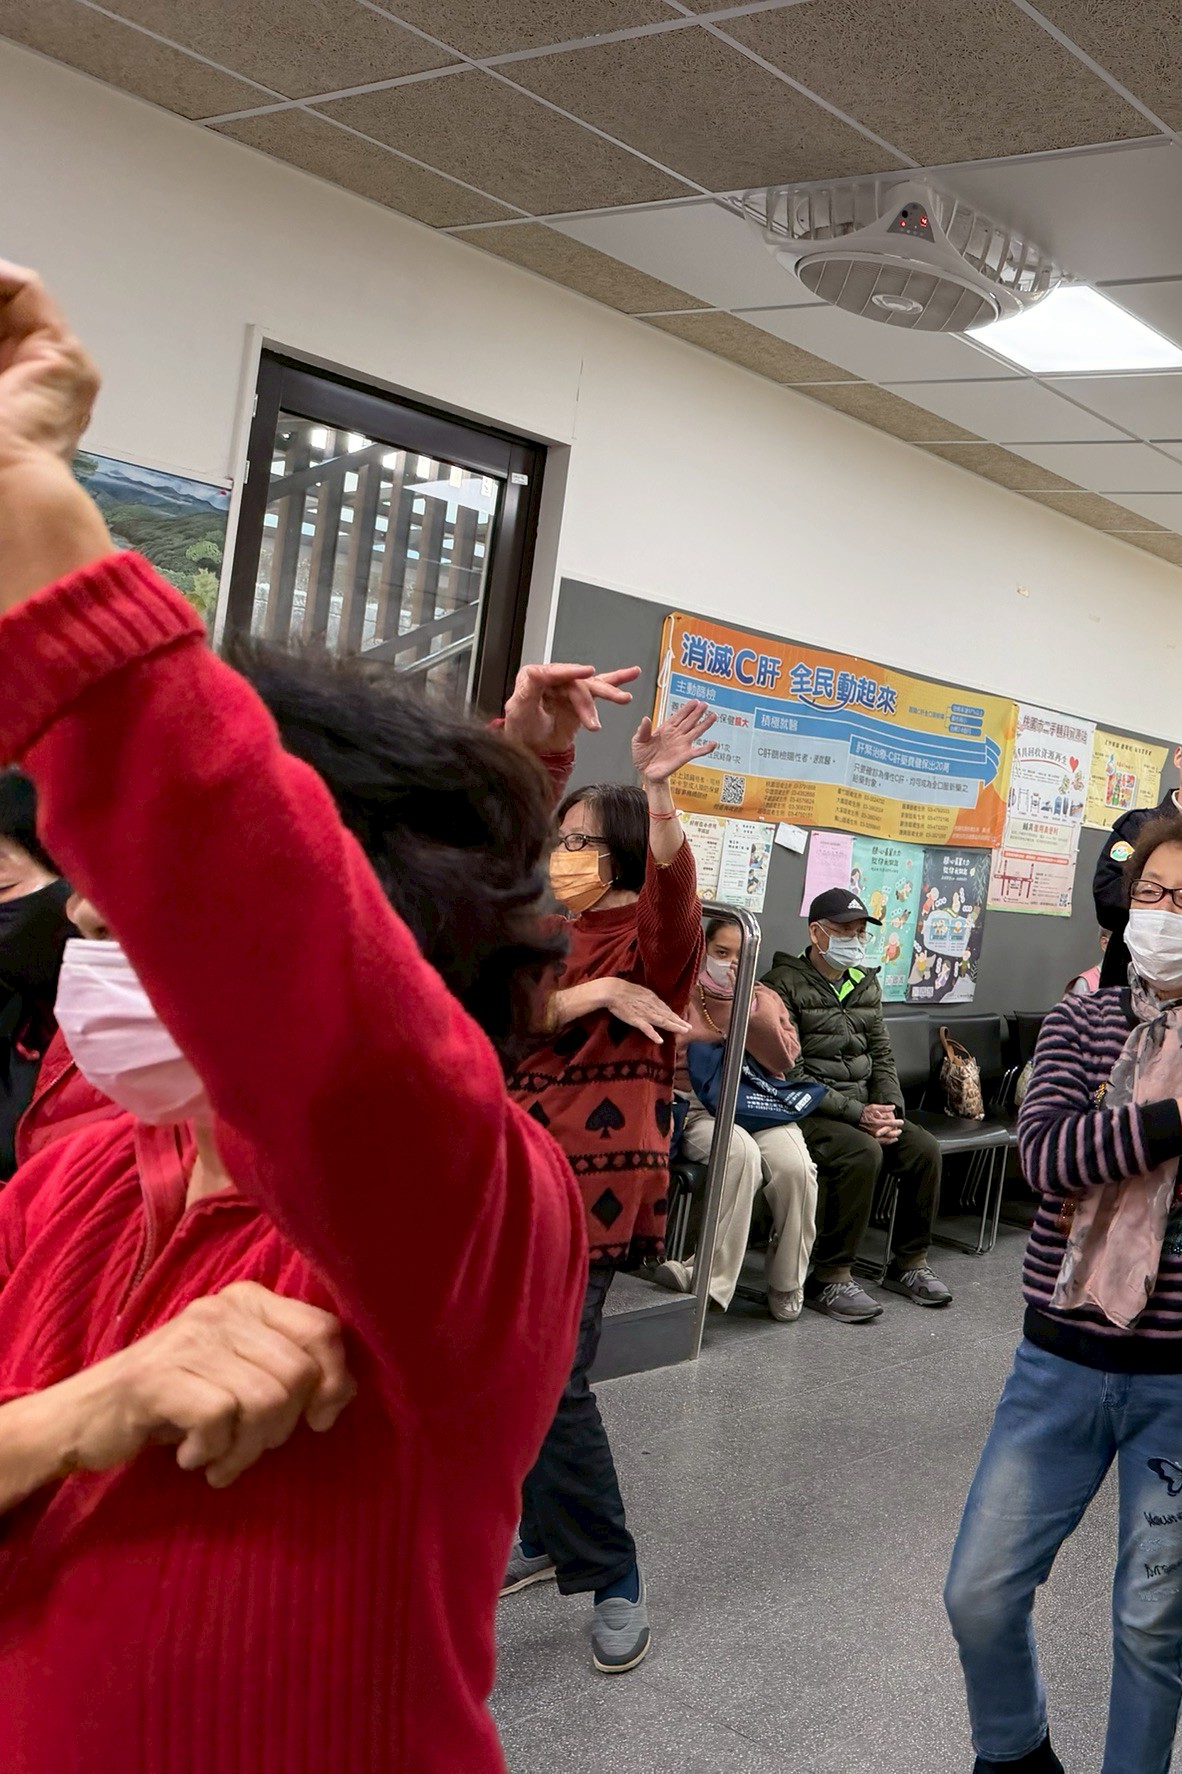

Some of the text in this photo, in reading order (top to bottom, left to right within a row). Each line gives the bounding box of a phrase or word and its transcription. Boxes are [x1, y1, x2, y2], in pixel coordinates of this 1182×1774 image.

[682, 633, 898, 714] 消滅C肝 全民動起來
[675, 678, 717, 701] 主動篩檢
[760, 713, 798, 732] 積極就醫
